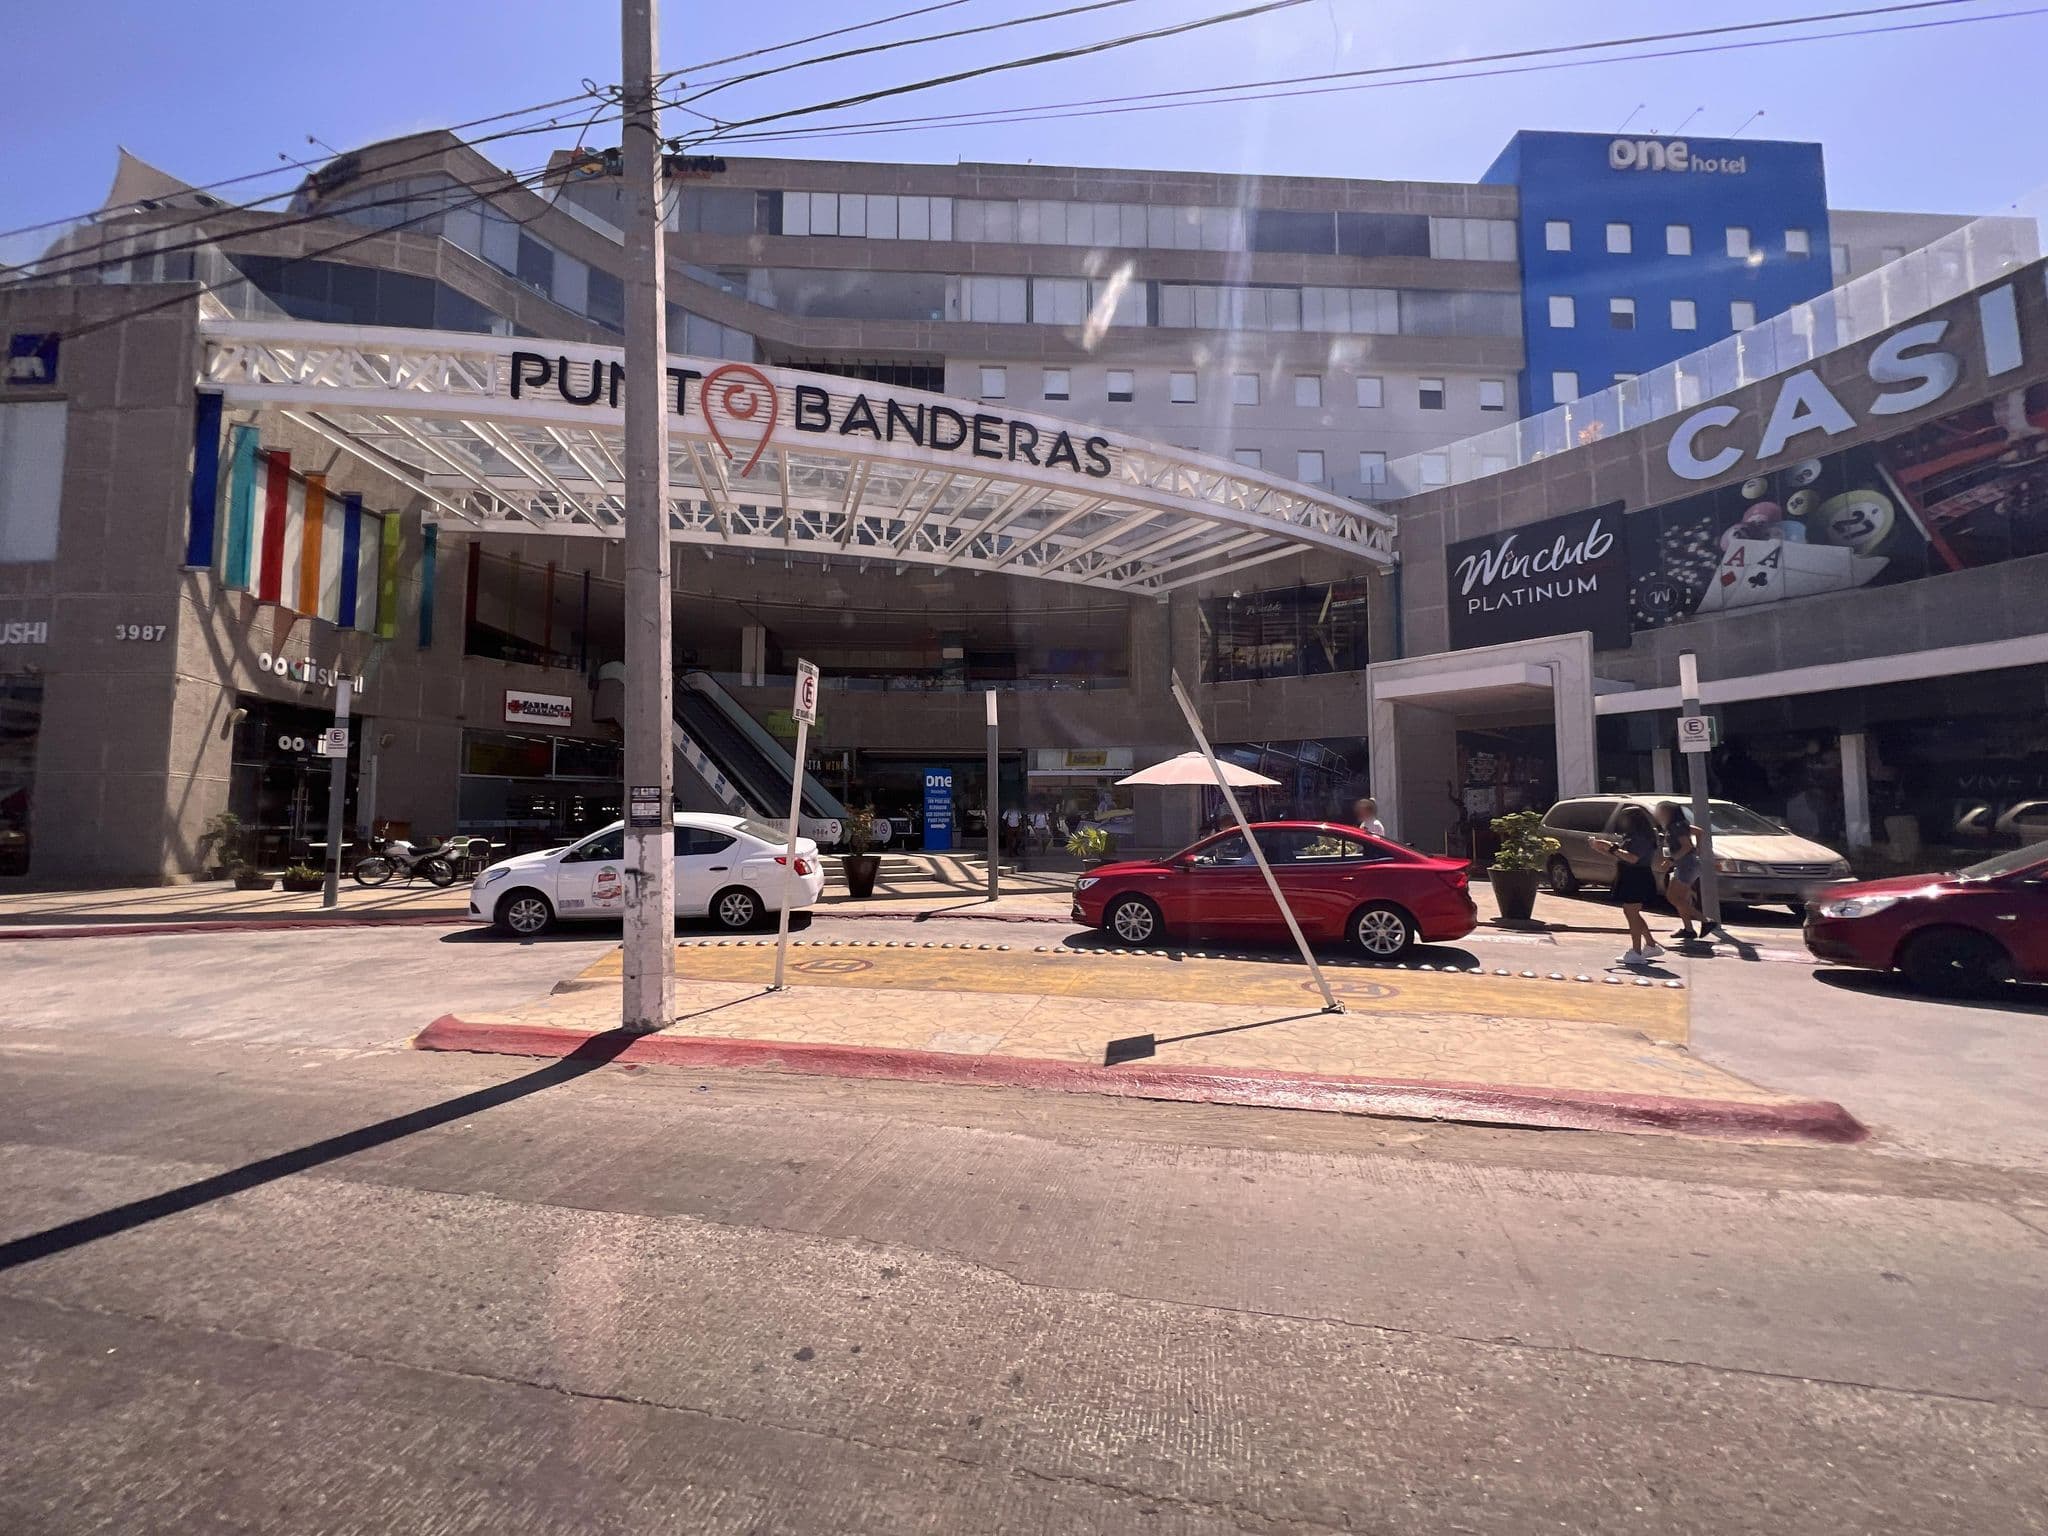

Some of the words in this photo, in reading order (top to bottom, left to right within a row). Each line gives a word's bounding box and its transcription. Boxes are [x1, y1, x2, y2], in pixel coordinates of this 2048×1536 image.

[1609, 139, 1689, 172] one
[1691, 154, 1747, 174] hotel
[1667, 266, 2048, 480] CASI
[795, 384, 1112, 478] BANDERAS
[1454, 518, 1614, 595] Winclub
[1468, 574, 1598, 614] PLATINUM
[115, 624, 167, 642] 3987
[926, 775, 953, 788] one
